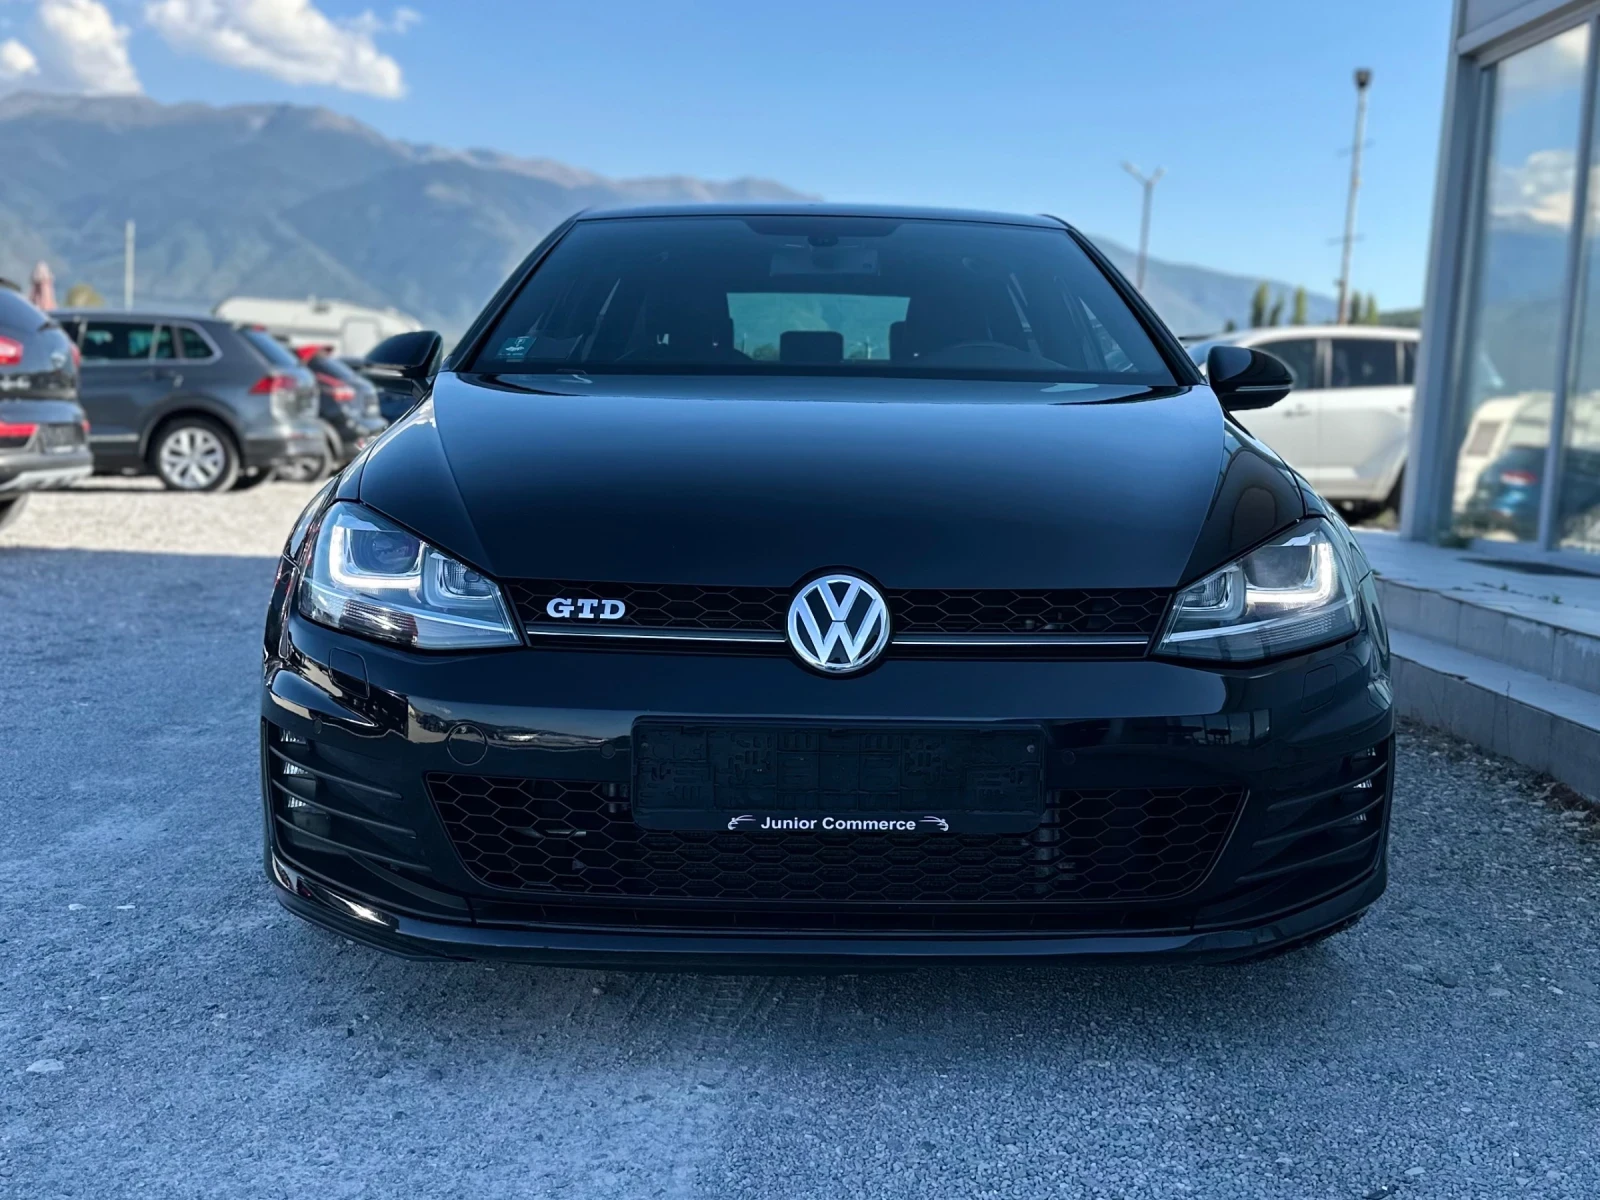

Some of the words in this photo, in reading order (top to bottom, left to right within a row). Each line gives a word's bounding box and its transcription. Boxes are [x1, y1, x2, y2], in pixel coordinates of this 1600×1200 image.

[546, 597, 626, 620] GTD
[761, 816, 817, 830] Junior
[822, 817, 917, 831] Commerce
